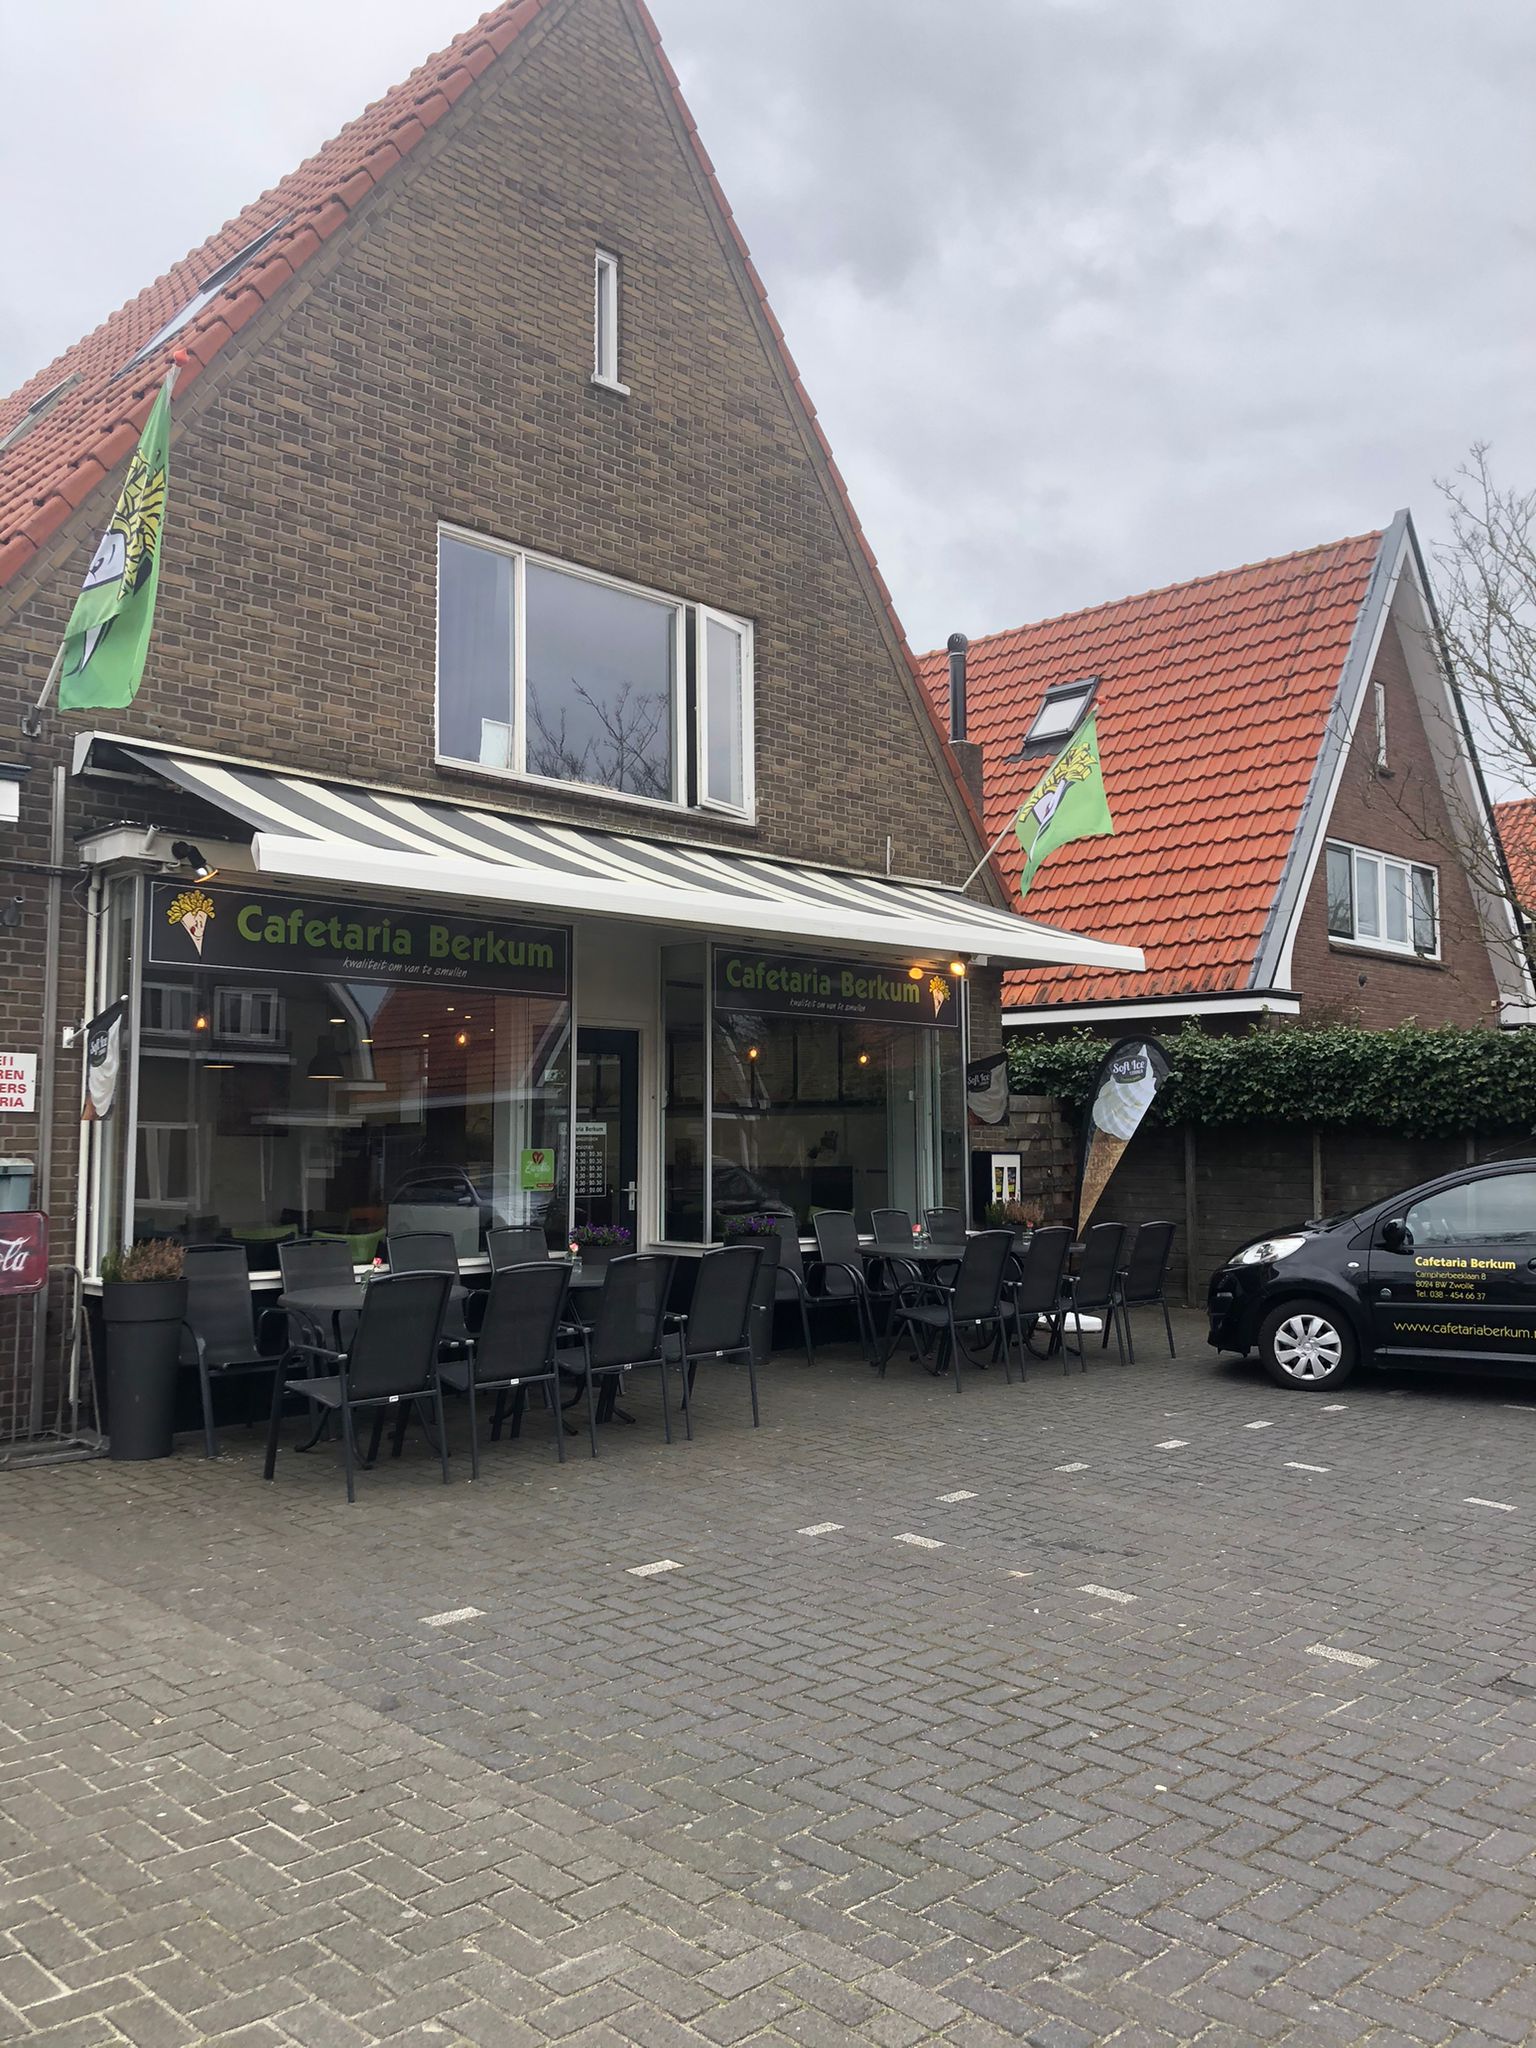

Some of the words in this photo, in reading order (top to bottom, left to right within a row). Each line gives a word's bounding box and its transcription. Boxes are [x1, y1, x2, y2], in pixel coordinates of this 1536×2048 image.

[237, 905, 412, 955] Cafetaria
[428, 925, 554, 969] Berkum
[343, 956, 387, 970] kwaliteit
[388, 962, 402, 972] om
[404, 964, 419, 973] van
[422, 964, 432, 975] te
[434, 967, 468, 978] smullen
[726, 959, 830, 995] Cafetaria
[841, 971, 920, 1003] Berkum
[1113, 1061, 1130, 1075] Soft
[1131, 1060, 1145, 1070] Ice
[0, 1097, 24, 1107] RIA
[1415, 1256, 1467, 1268] Cafetaria
[1470, 1258, 1516, 1270] Berkum
[1416, 1270, 1480, 1280] Campherbeeklaan
[1481, 1272, 1487, 1280] 8
[1449, 1282, 1475, 1290] Zwolle
[1429, 1291, 1444, 1299] 038
[1465, 1292, 1475, 1300] 66
[1393, 1322, 1536, 1339] www.cafetariaberkum.
